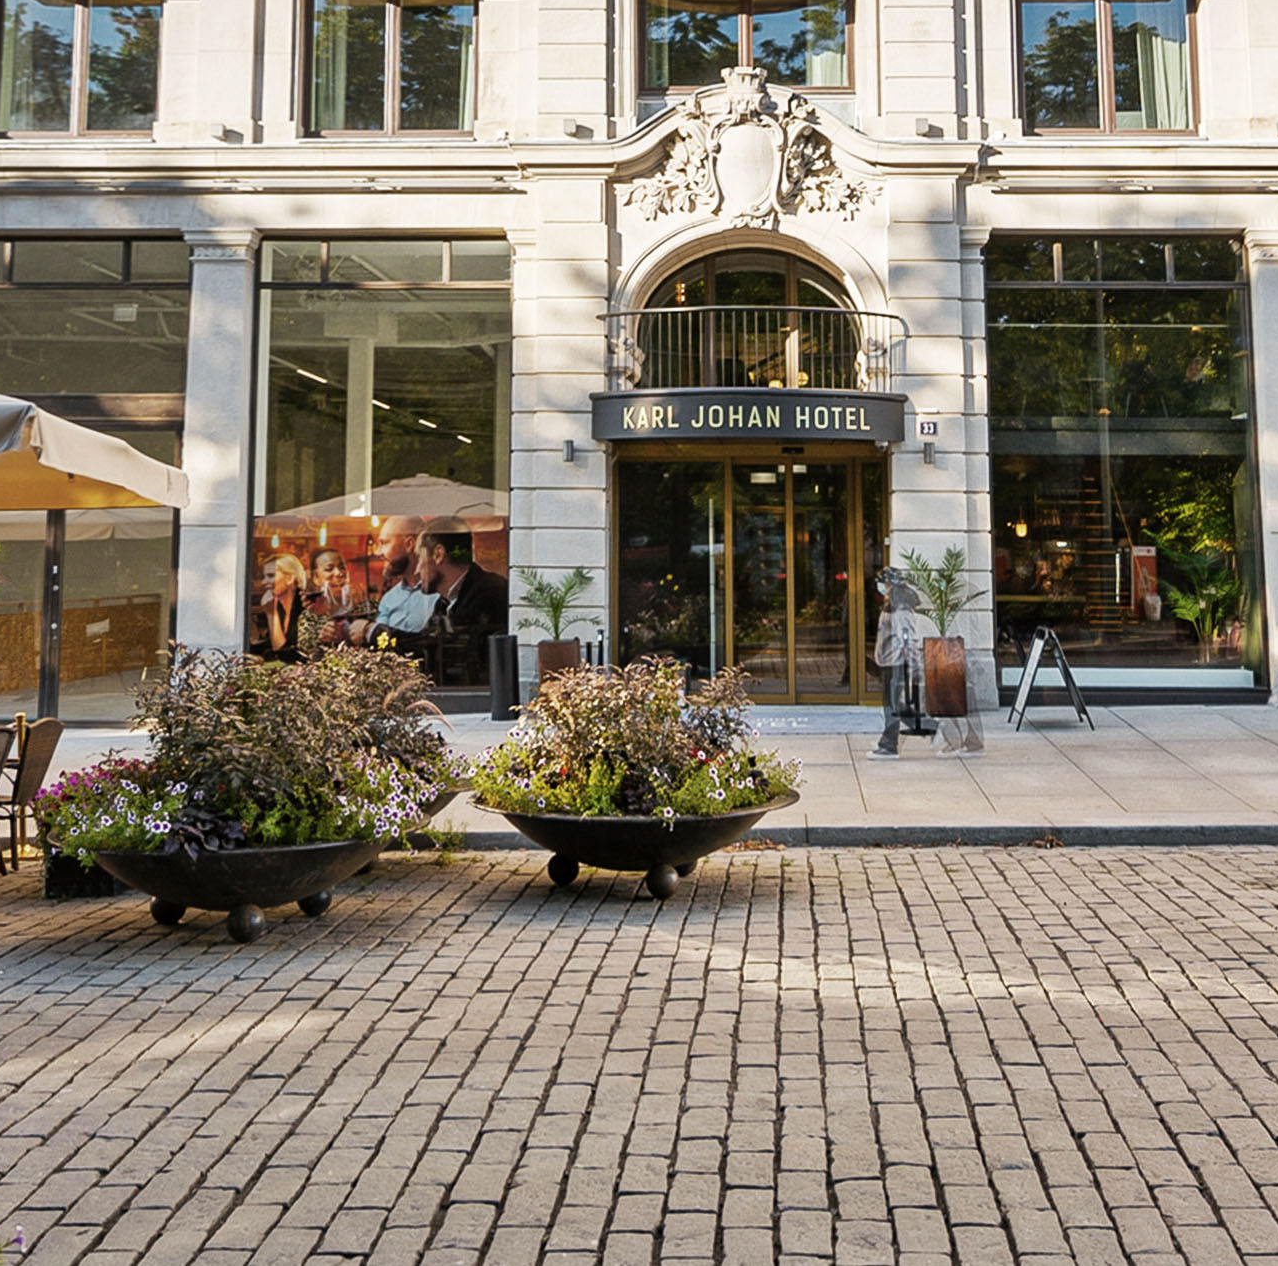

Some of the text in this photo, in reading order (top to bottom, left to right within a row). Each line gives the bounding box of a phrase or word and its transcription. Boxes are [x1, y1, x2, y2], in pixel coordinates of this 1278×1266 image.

[623, 405, 871, 430] KARL JOHAN HOTEL
[923, 423, 934, 434] 33
